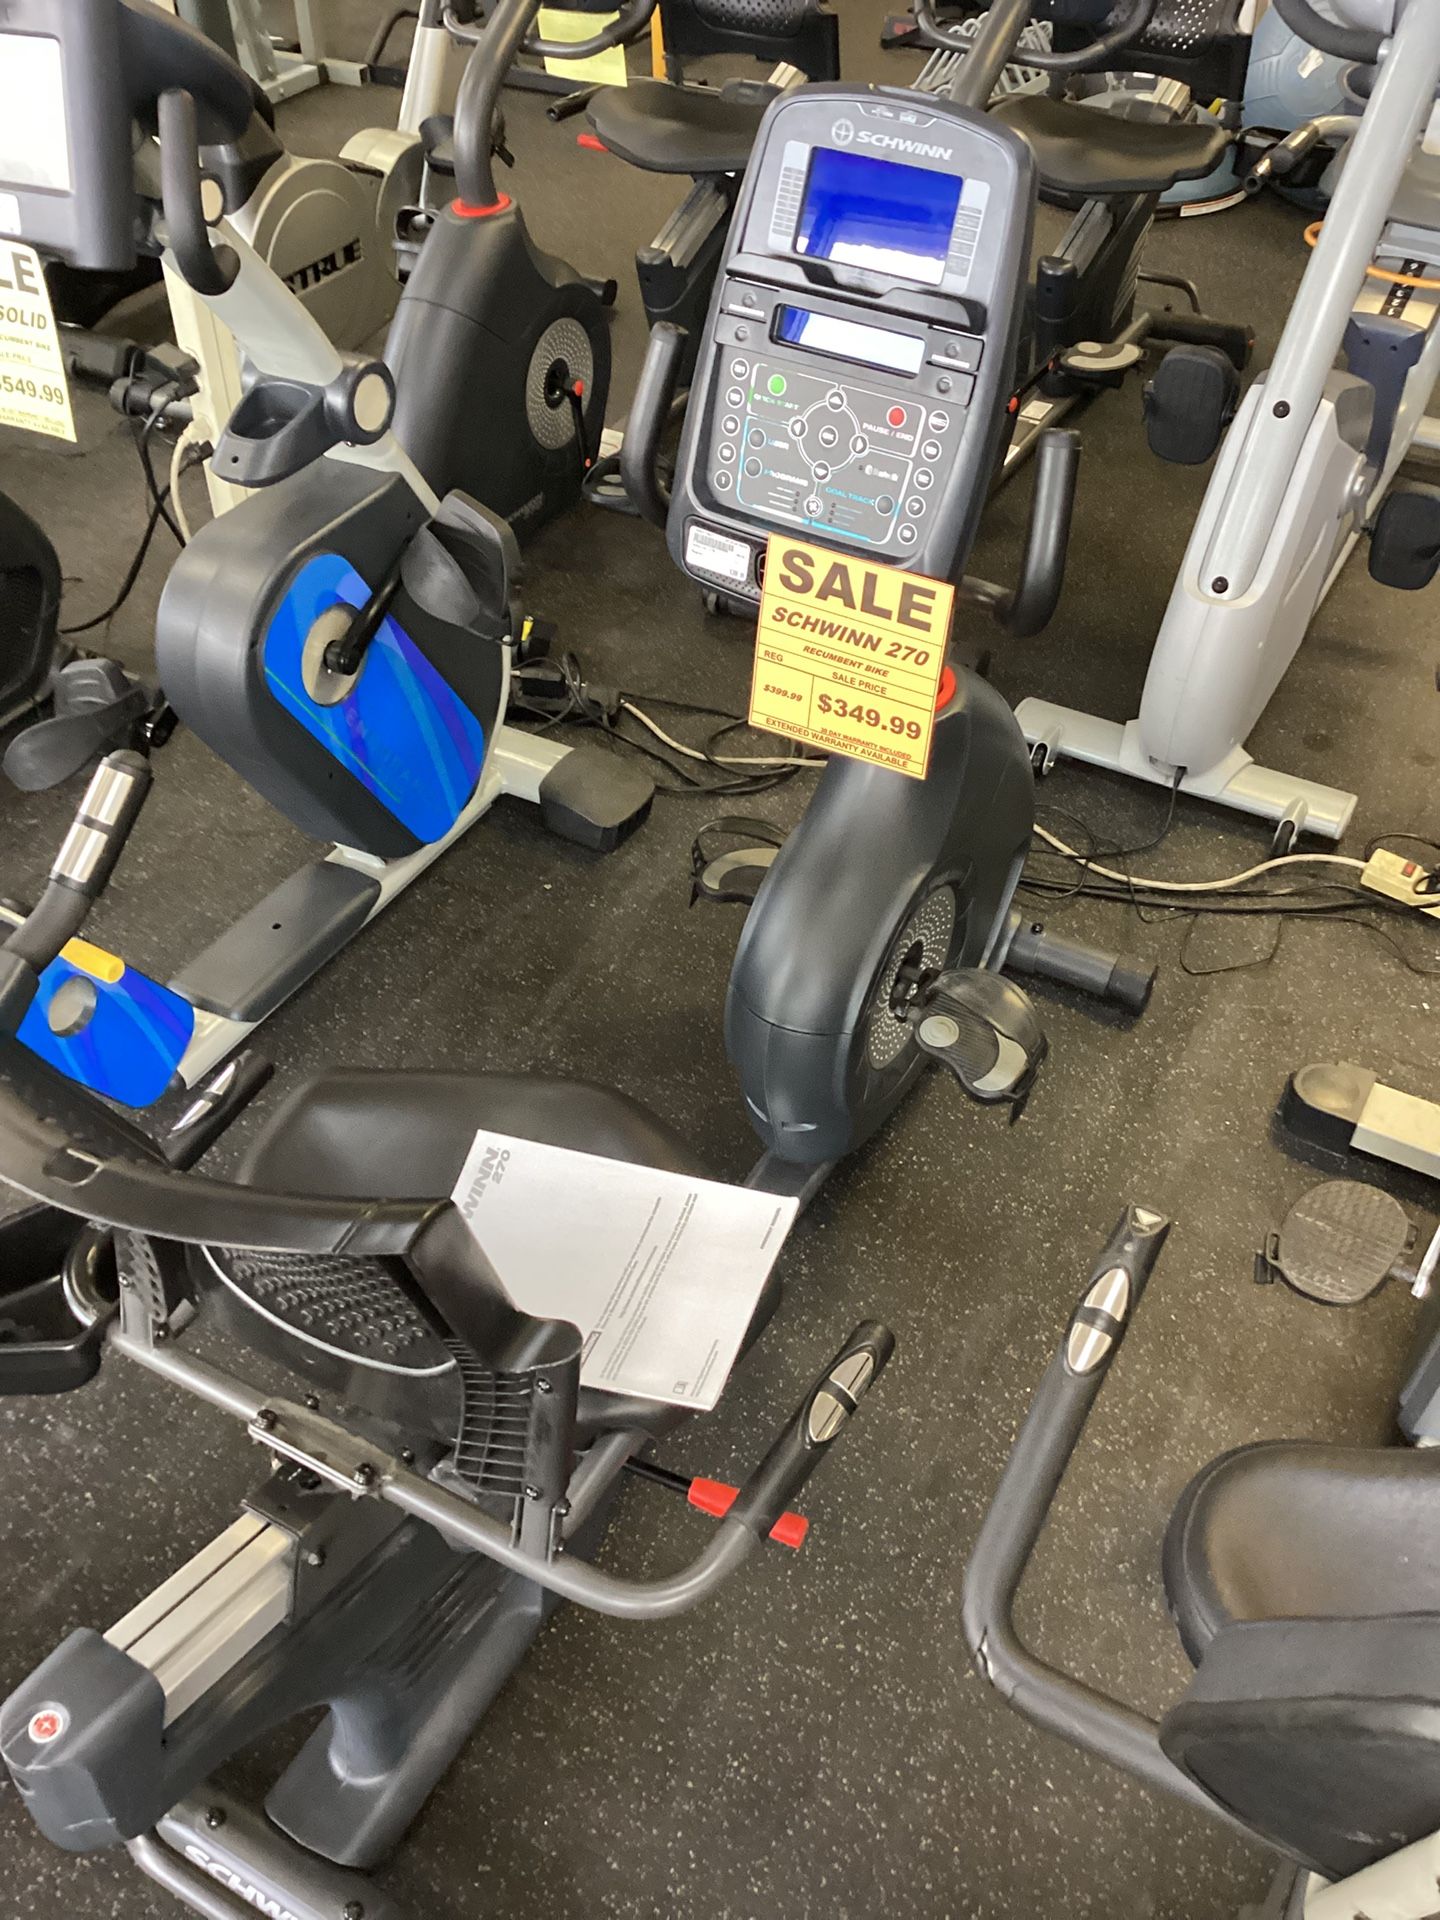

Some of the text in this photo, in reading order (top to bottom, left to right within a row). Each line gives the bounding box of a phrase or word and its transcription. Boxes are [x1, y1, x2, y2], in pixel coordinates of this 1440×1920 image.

[856, 131, 953, 161] SCHWINN
[288, 237, 362, 290] TRUE
[862, 422, 890, 436] PAUSE
[896, 431, 915, 442] END
[779, 548, 936, 633] SALE
[771, 606, 930, 667] SCHWINN 270
[764, 650, 783, 662] REG
[803, 645, 890, 679] RECUMBENT BIKE
[763, 684, 803, 702] $399.99
[832, 671, 888, 695] SALE PRICE
[817, 693, 921, 740] $349.99
[766, 717, 909, 768] EXTENDED WARRANTY AVAILABLE
[492, 1149, 511, 1185] 270
